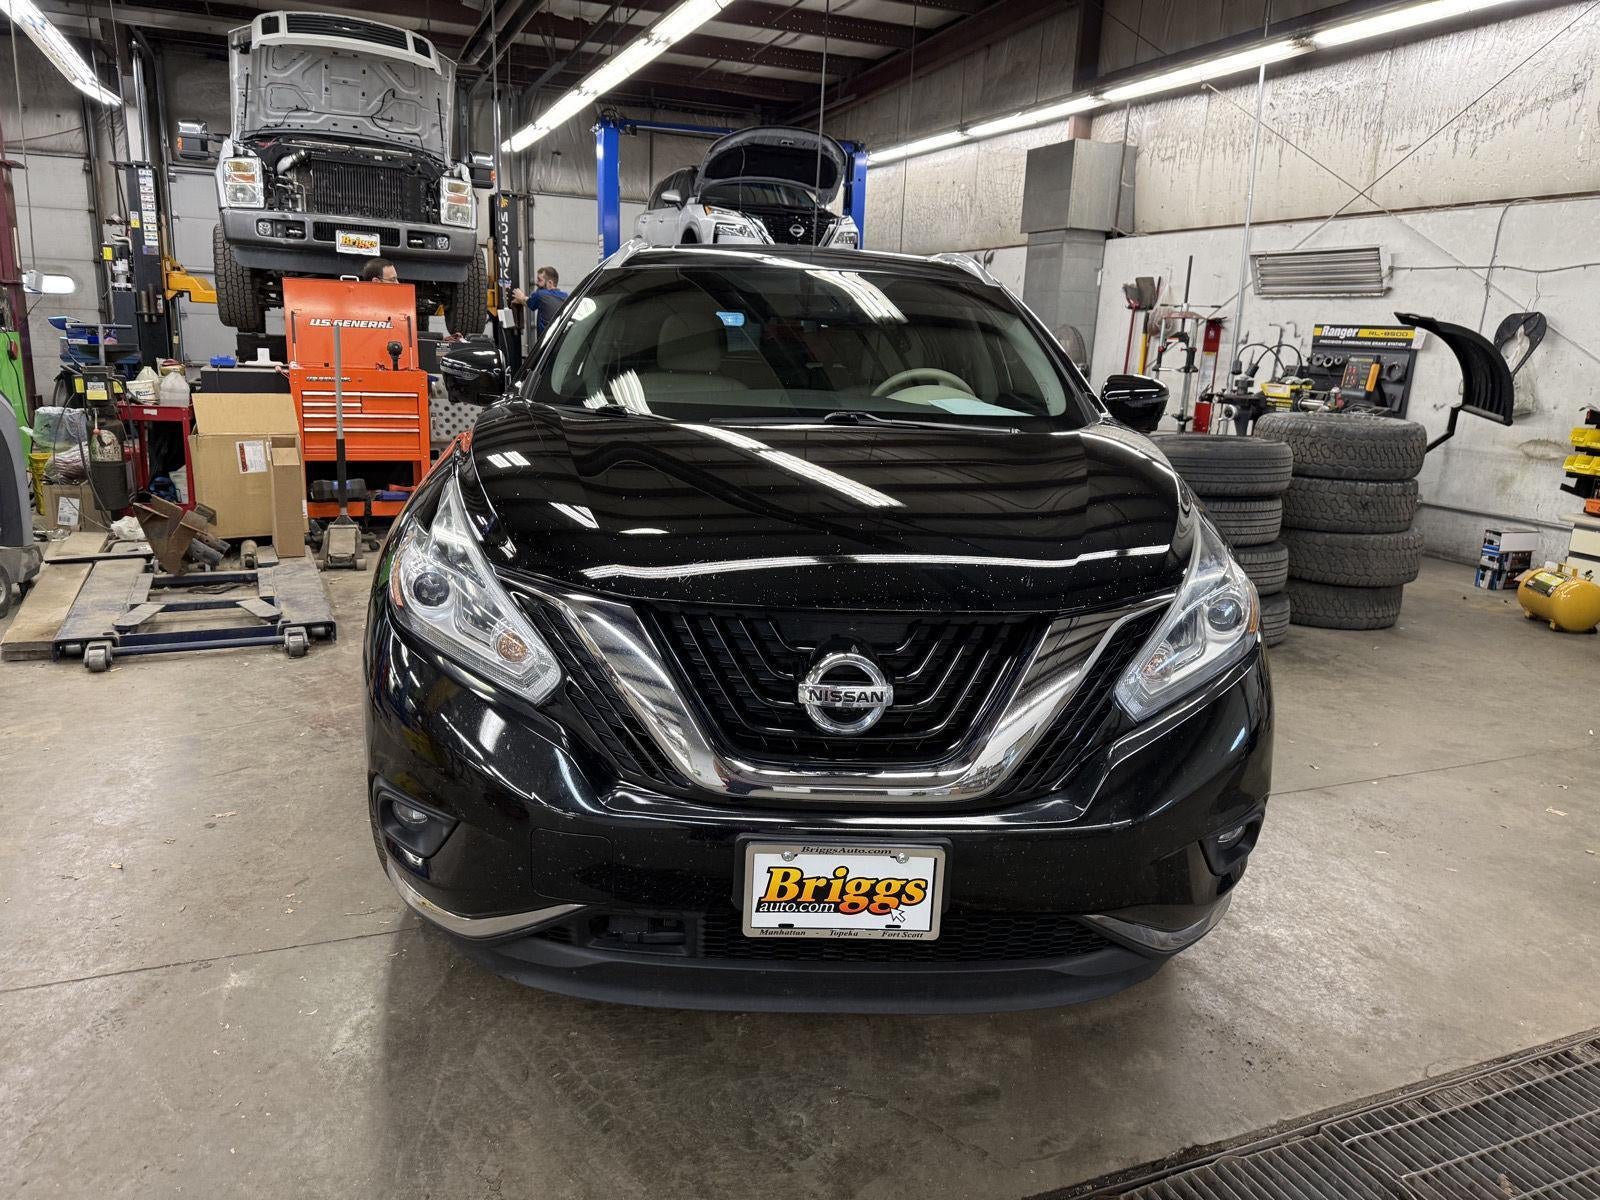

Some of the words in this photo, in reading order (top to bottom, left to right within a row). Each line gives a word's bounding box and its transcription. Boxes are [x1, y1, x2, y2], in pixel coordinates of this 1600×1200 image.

[341, 235, 378, 250] Briggs
[333, 319, 394, 329] GENERAL
[1321, 325, 1359, 339] Ranger
[1368, 330, 1409, 338] RL-8500
[808, 689, 884, 703] NISSAN
[801, 845, 892, 855] BriggsAuto.com
[761, 865, 929, 916] Briggs
[759, 900, 835, 913] auto.com
[829, 929, 859, 938] Topeka
[881, 931, 900, 939] Fort
[901, 931, 924, 939] Scott
